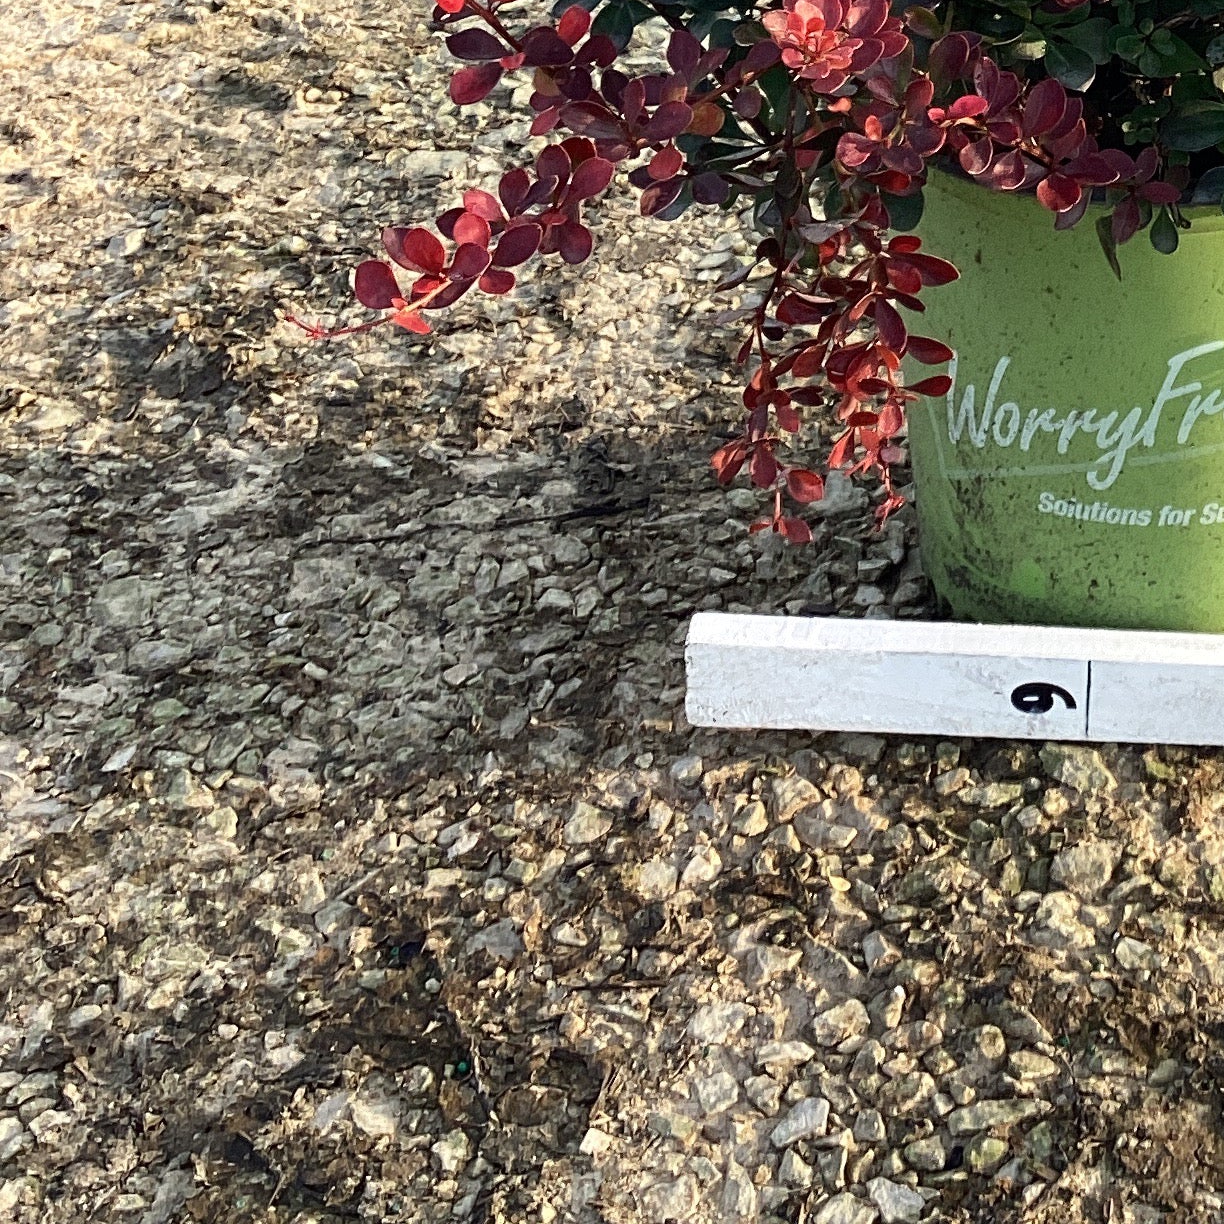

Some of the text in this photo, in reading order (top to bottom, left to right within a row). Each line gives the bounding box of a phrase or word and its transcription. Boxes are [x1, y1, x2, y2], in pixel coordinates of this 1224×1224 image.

[1038, 491, 1152, 527] Solutions
[1157, 505, 1197, 527] for
[1010, 682, 1077, 715] 6
